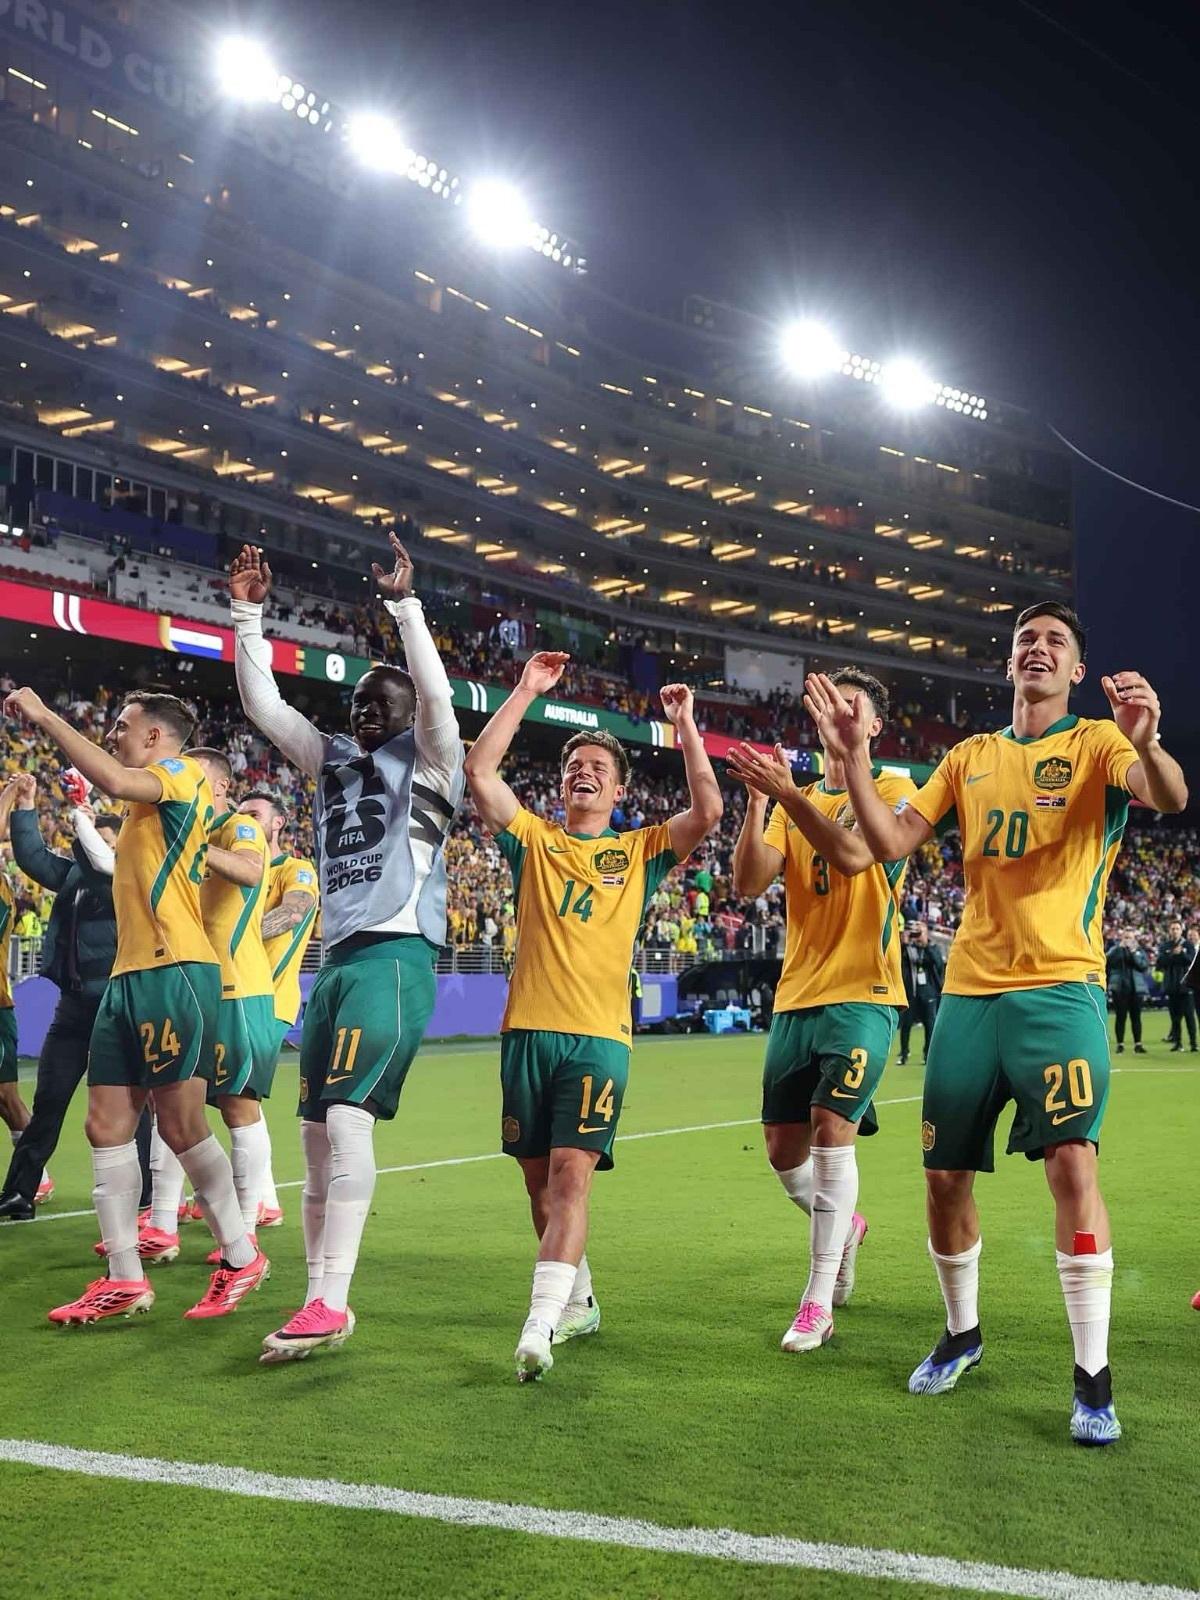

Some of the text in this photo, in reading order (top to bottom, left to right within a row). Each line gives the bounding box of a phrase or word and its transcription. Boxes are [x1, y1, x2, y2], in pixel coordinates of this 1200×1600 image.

[326, 653, 346, 682] 0
[544, 703, 599, 728] AUSTRALIA
[338, 830, 366, 848] FIFA
[982, 809, 1029, 859] 20
[326, 853, 383, 877] WORLD CUP
[326, 866, 383, 895] 2026
[813, 855, 830, 896] 3
[558, 879, 595, 923] 14
[139, 1018, 181, 1063] 24
[214, 1043, 227, 1076] 2
[332, 1027, 362, 1071] 11
[844, 1048, 868, 1089] 3
[1043, 1058, 1094, 1113] 20
[580, 1075, 614, 1123] 14
